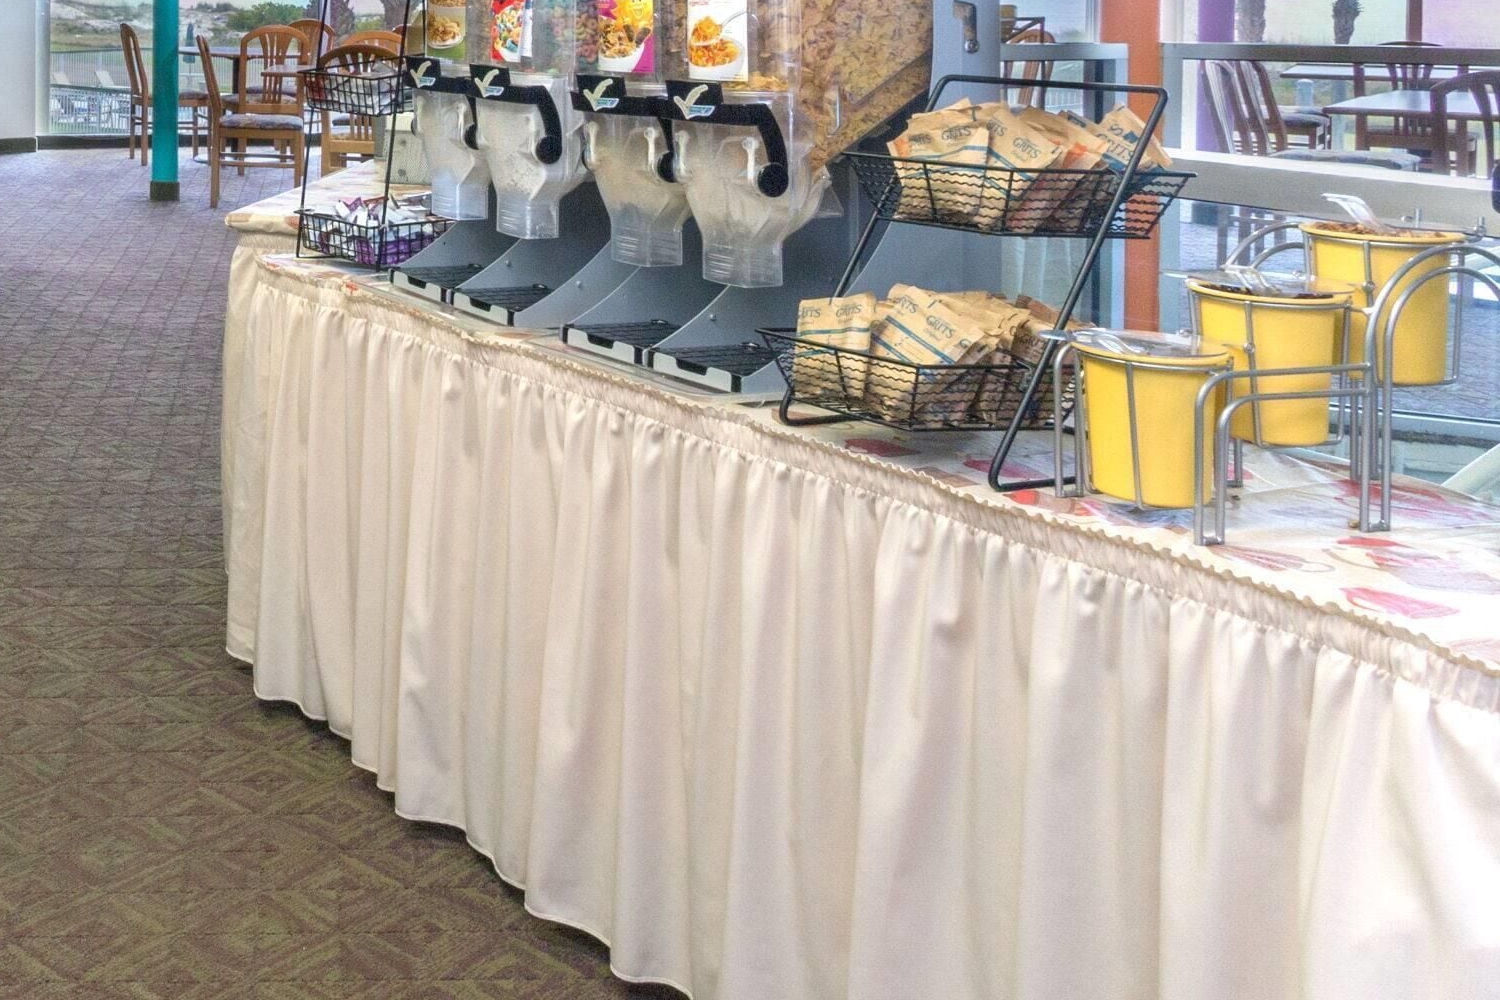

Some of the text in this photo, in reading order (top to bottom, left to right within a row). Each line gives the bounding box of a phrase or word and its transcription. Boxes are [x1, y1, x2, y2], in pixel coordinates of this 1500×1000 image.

[1013, 137, 1041, 159] GRITS
[801, 307, 821, 319] RITS
[835, 303, 863, 318] GRITS
[901, 295, 917, 314] RITS
[926, 315, 957, 339] GRITS
